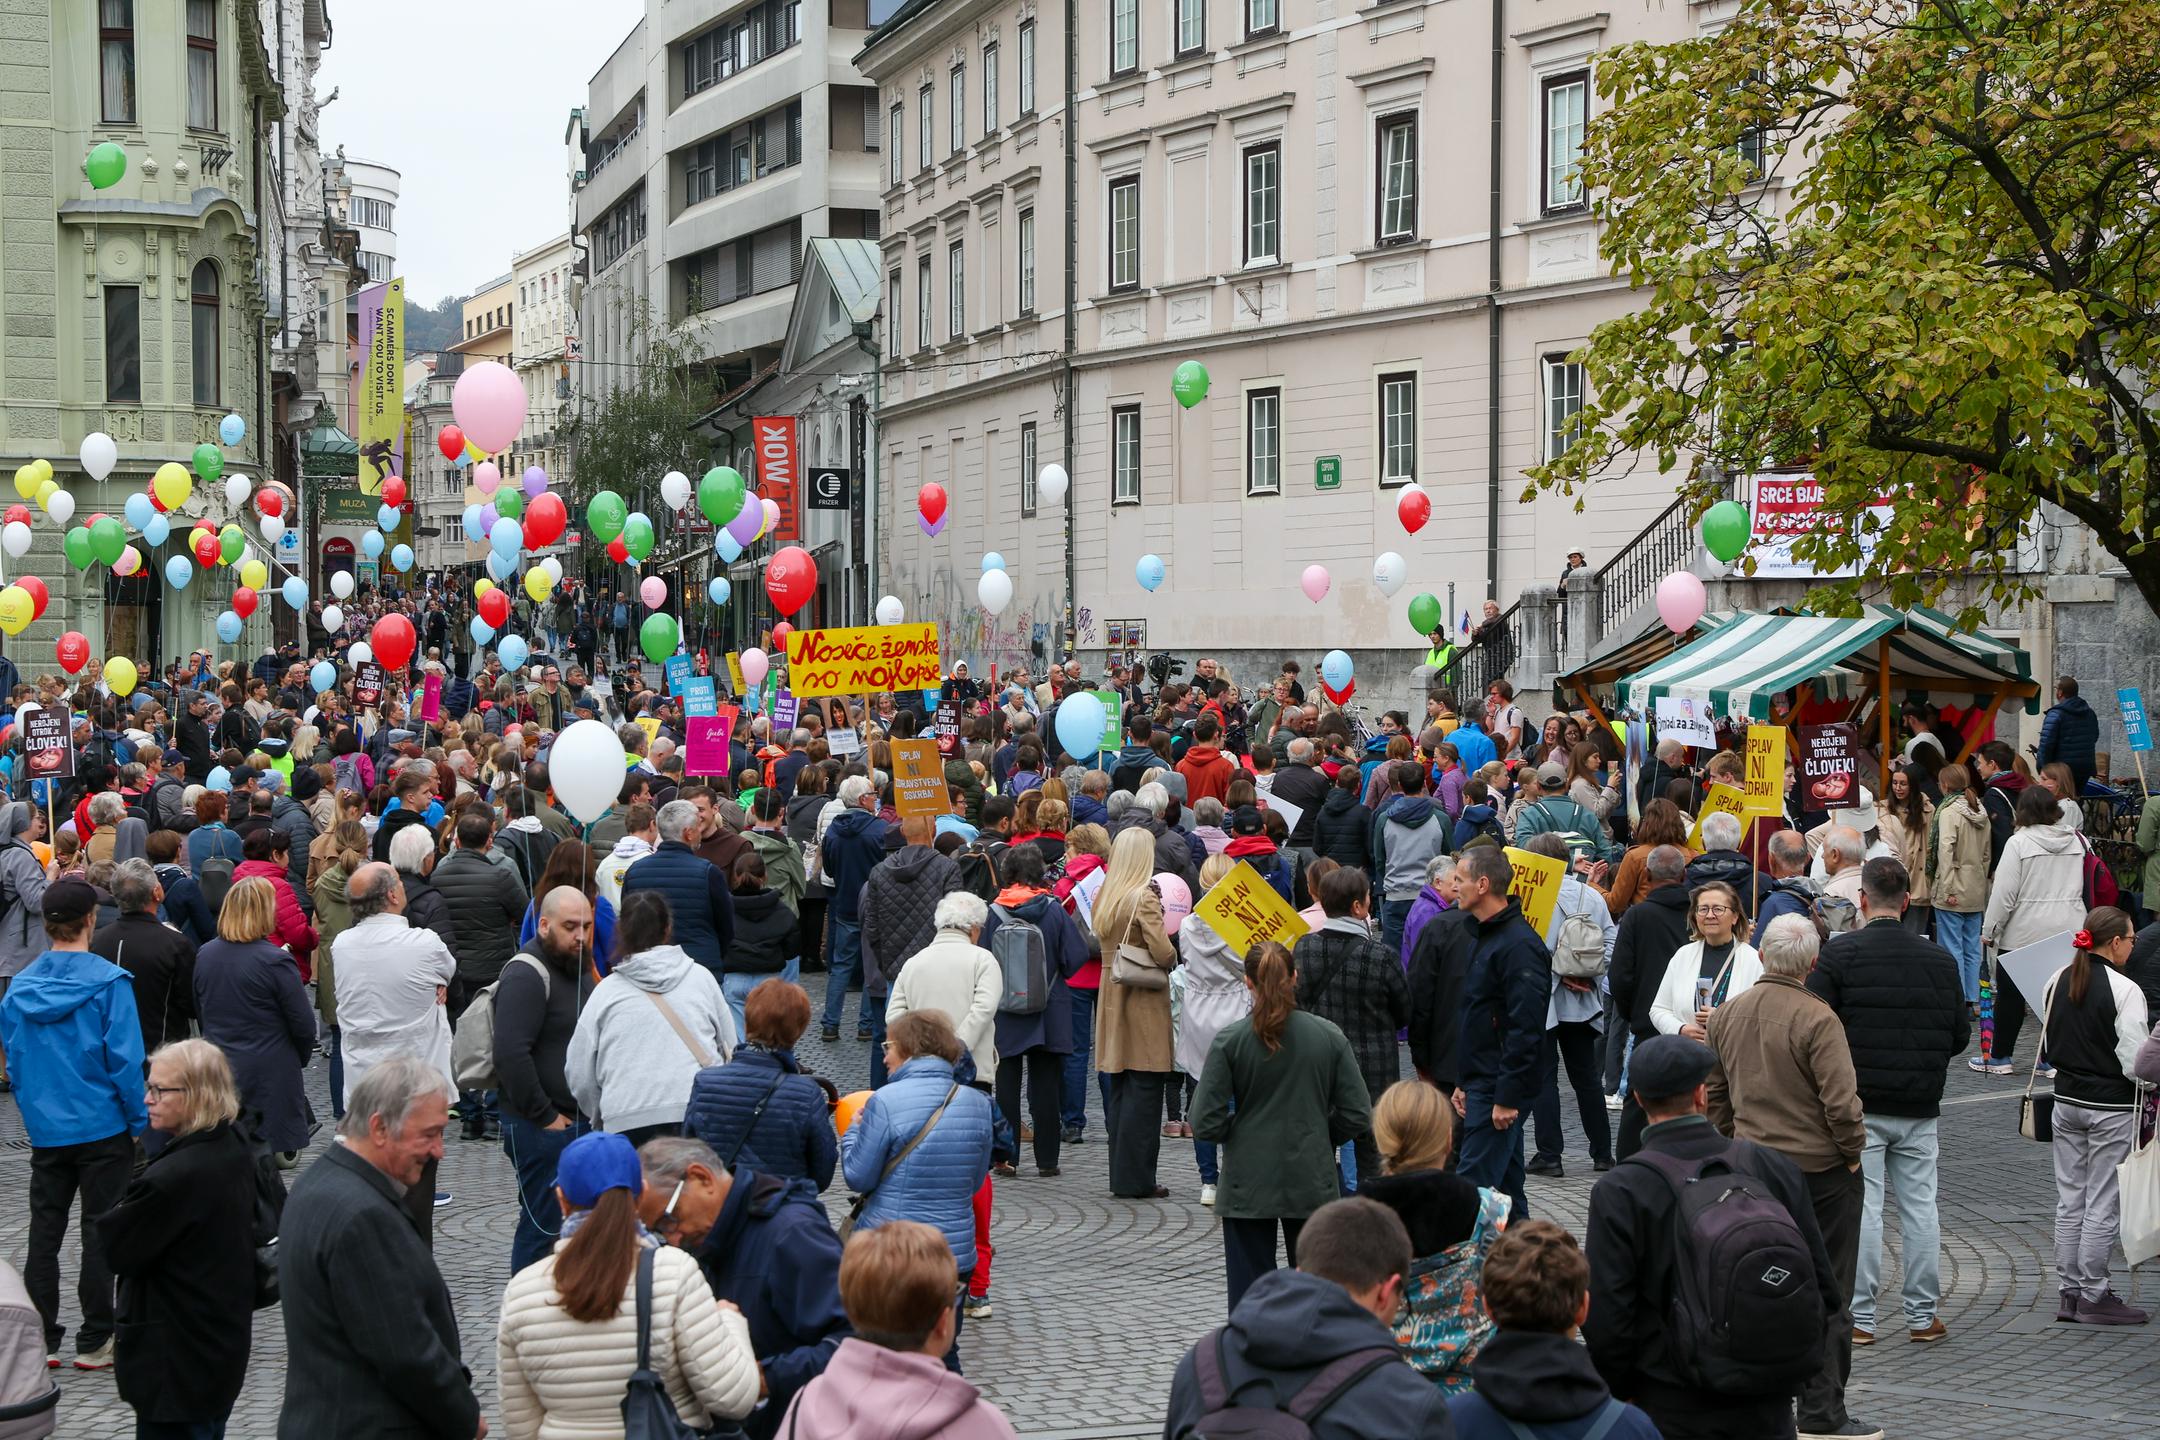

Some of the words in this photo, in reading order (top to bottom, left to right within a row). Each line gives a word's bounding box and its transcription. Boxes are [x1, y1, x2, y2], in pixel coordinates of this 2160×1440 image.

[375, 307, 383, 339] WANT
[386, 307, 394, 360] SCAMMERS
[375, 338, 383, 359] YOU
[375, 361, 383, 374] TO
[386, 363, 394, 394] DON'T
[375, 375, 383, 401] VISIT
[375, 402, 383, 417] US.
[1760, 486, 1793, 504] SRCE
[1796, 485, 1825, 503] BIJE
[340, 499, 367, 508] MUZA
[791, 631, 879, 665] Noseče
[881, 628, 939, 659] ženske
[670, 666, 690, 678] HEARTS
[356, 677, 382, 690] ČLOVEK!
[689, 685, 709, 696] PROTI
[689, 702, 713, 712] BOLNIH
[778, 698, 793, 708] PROTI
[29, 718, 61, 728] NEROJENI
[774, 713, 793, 723] BOLNIH
[32, 727, 53, 737] OTROK
[934, 721, 959, 736] ČLOVEK!
[1821, 729, 1836, 737] VSAK
[25, 735, 68, 751] ČLOVEK!
[1747, 738, 1773, 754] SPLAV
[1810, 735, 1847, 748] NEROJENI
[899, 750, 921, 760] SPLAV
[1813, 747, 1838, 758] OTROK
[1839, 748, 1846, 756] JE
[906, 762, 920, 776] NI
[1751, 755, 1765, 779] NI
[1804, 757, 1855, 776] ČLOVEK!
[903, 790, 934, 800] OSKRBA!
[1715, 794, 1744, 814] SPLAV
[1215, 880, 1251, 918] SPLAV
[1234, 900, 1265, 931] NI
